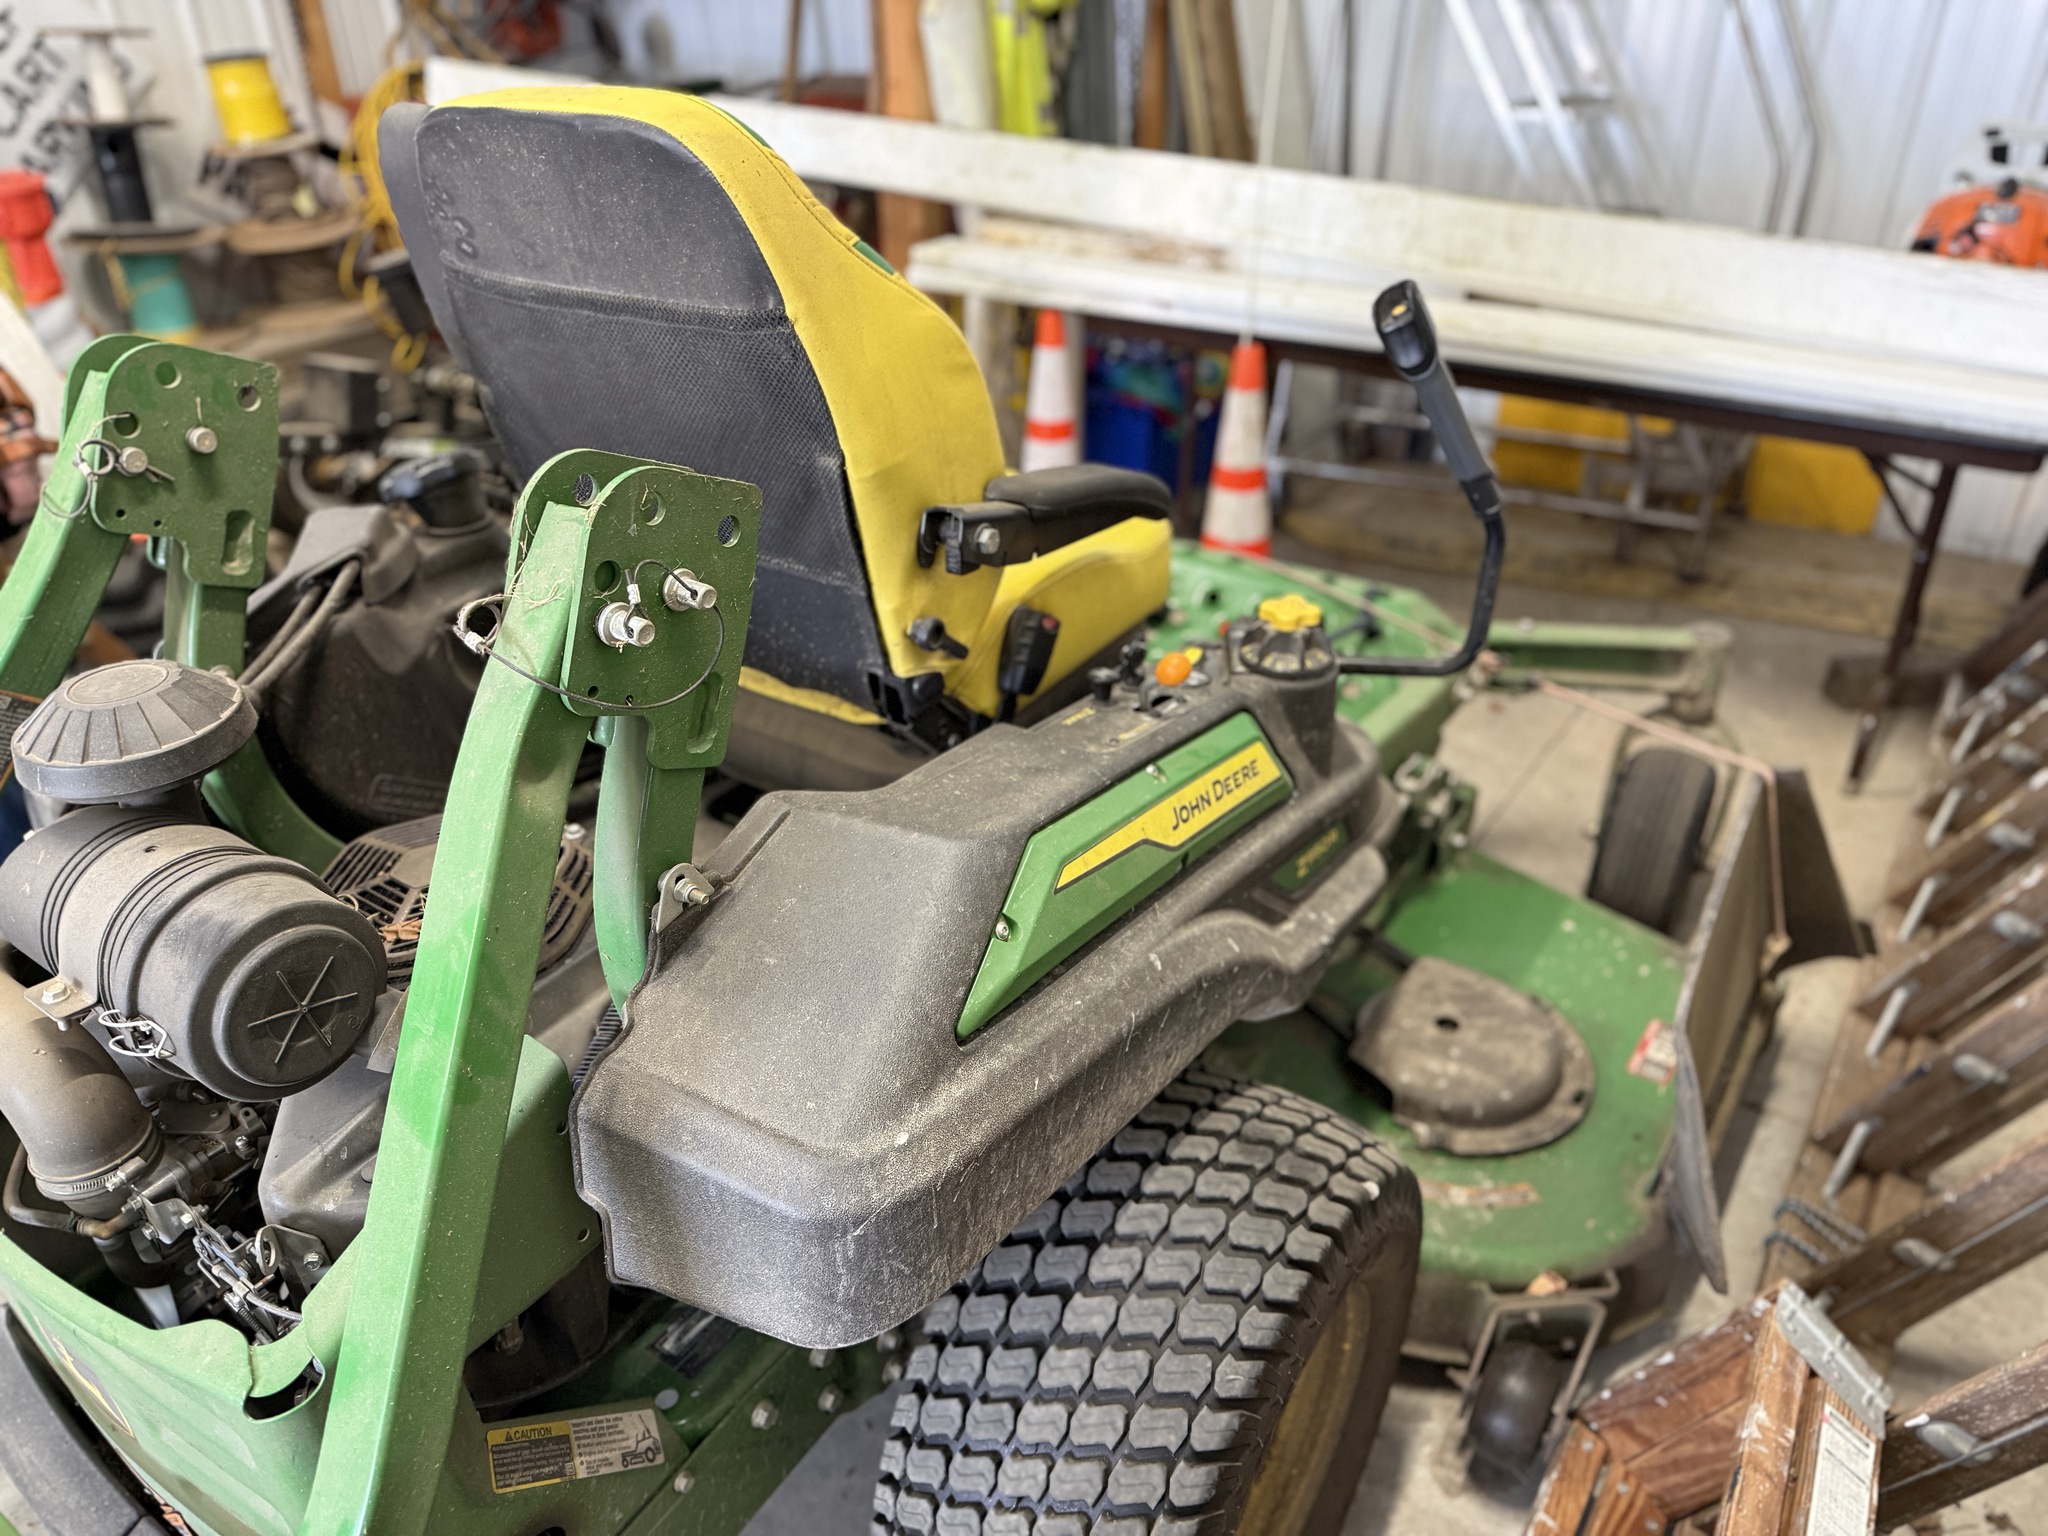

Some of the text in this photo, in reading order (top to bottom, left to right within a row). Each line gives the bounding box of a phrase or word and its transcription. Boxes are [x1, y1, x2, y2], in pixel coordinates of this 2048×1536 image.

[1172, 759, 1260, 831] JOHN DEERE
[514, 1426, 552, 1441] CAUTION
